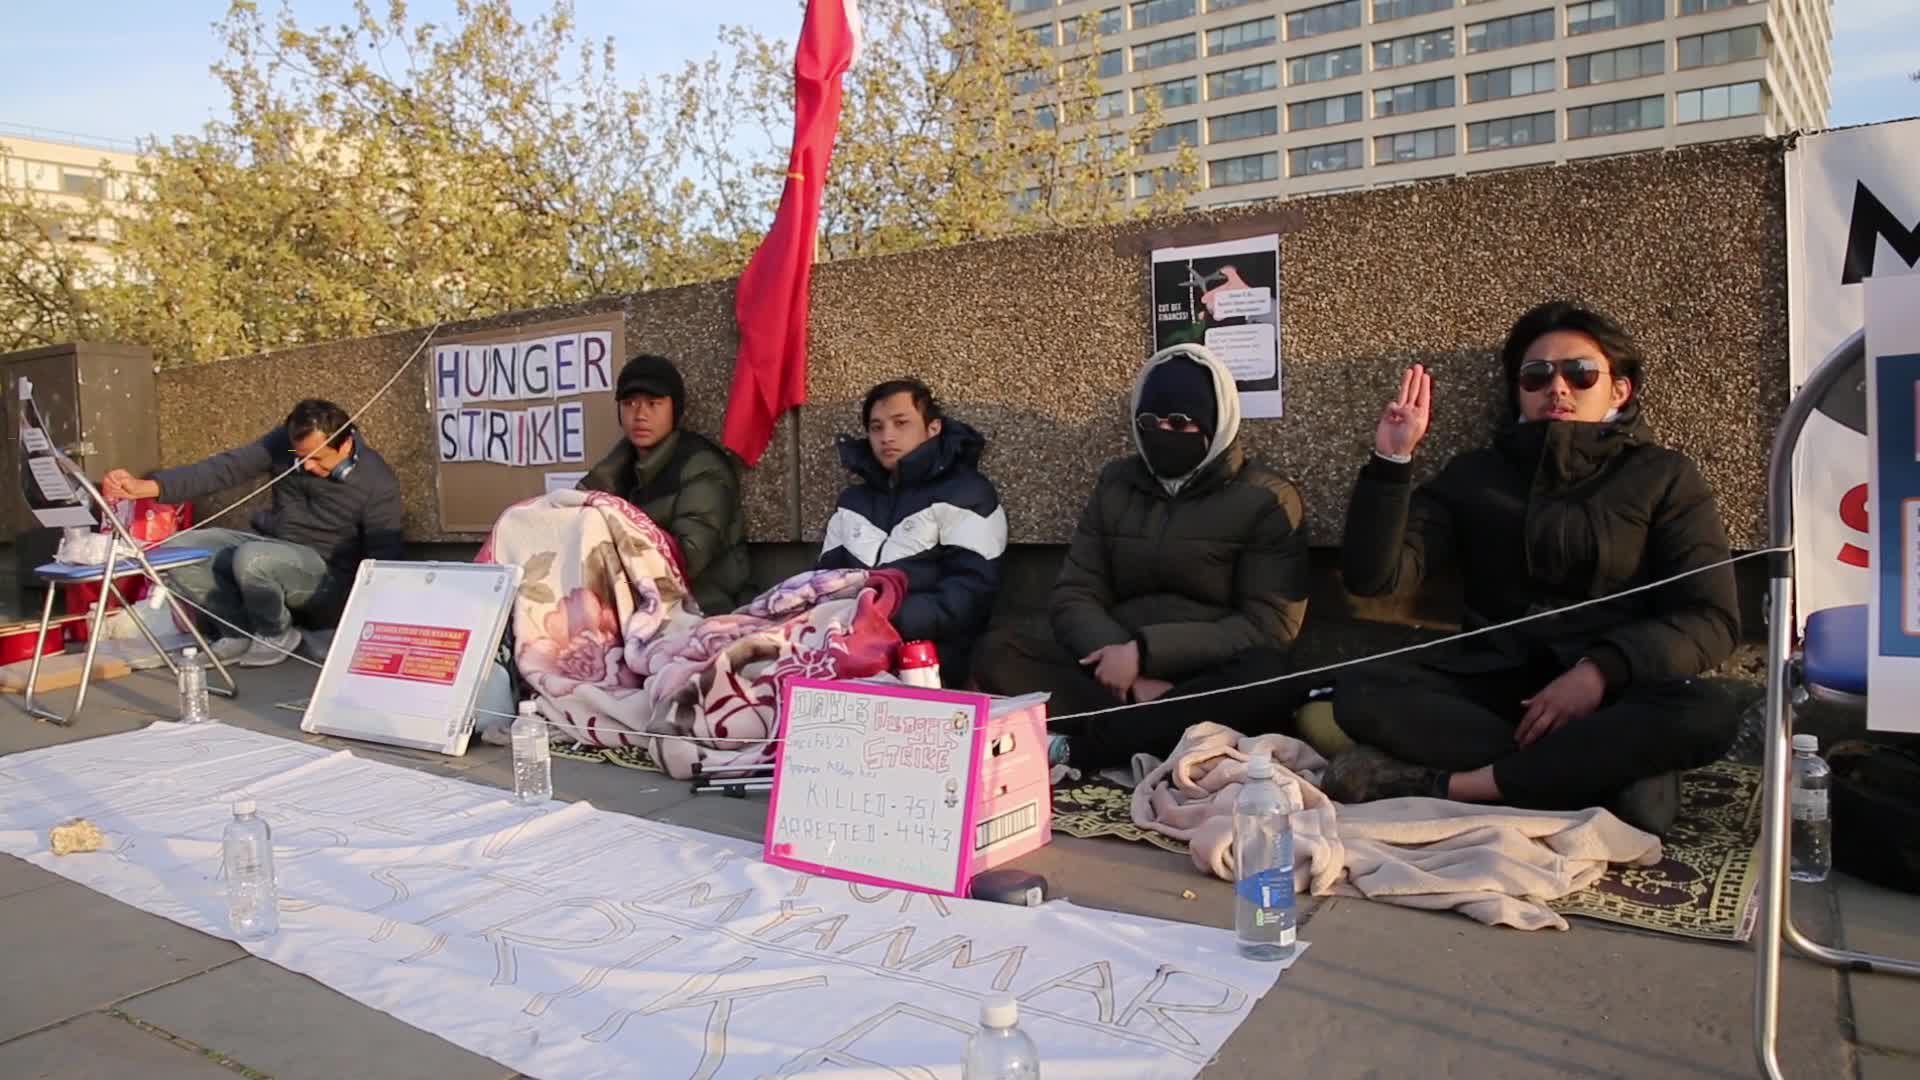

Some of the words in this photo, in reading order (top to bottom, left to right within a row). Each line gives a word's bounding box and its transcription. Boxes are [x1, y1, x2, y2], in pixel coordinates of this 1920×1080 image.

[438, 337, 608, 397] HUNGER
[441, 408, 582, 463] STRIKE
[807, 781, 886, 817] KILLED
[778, 815, 876, 843] ARRESTED
